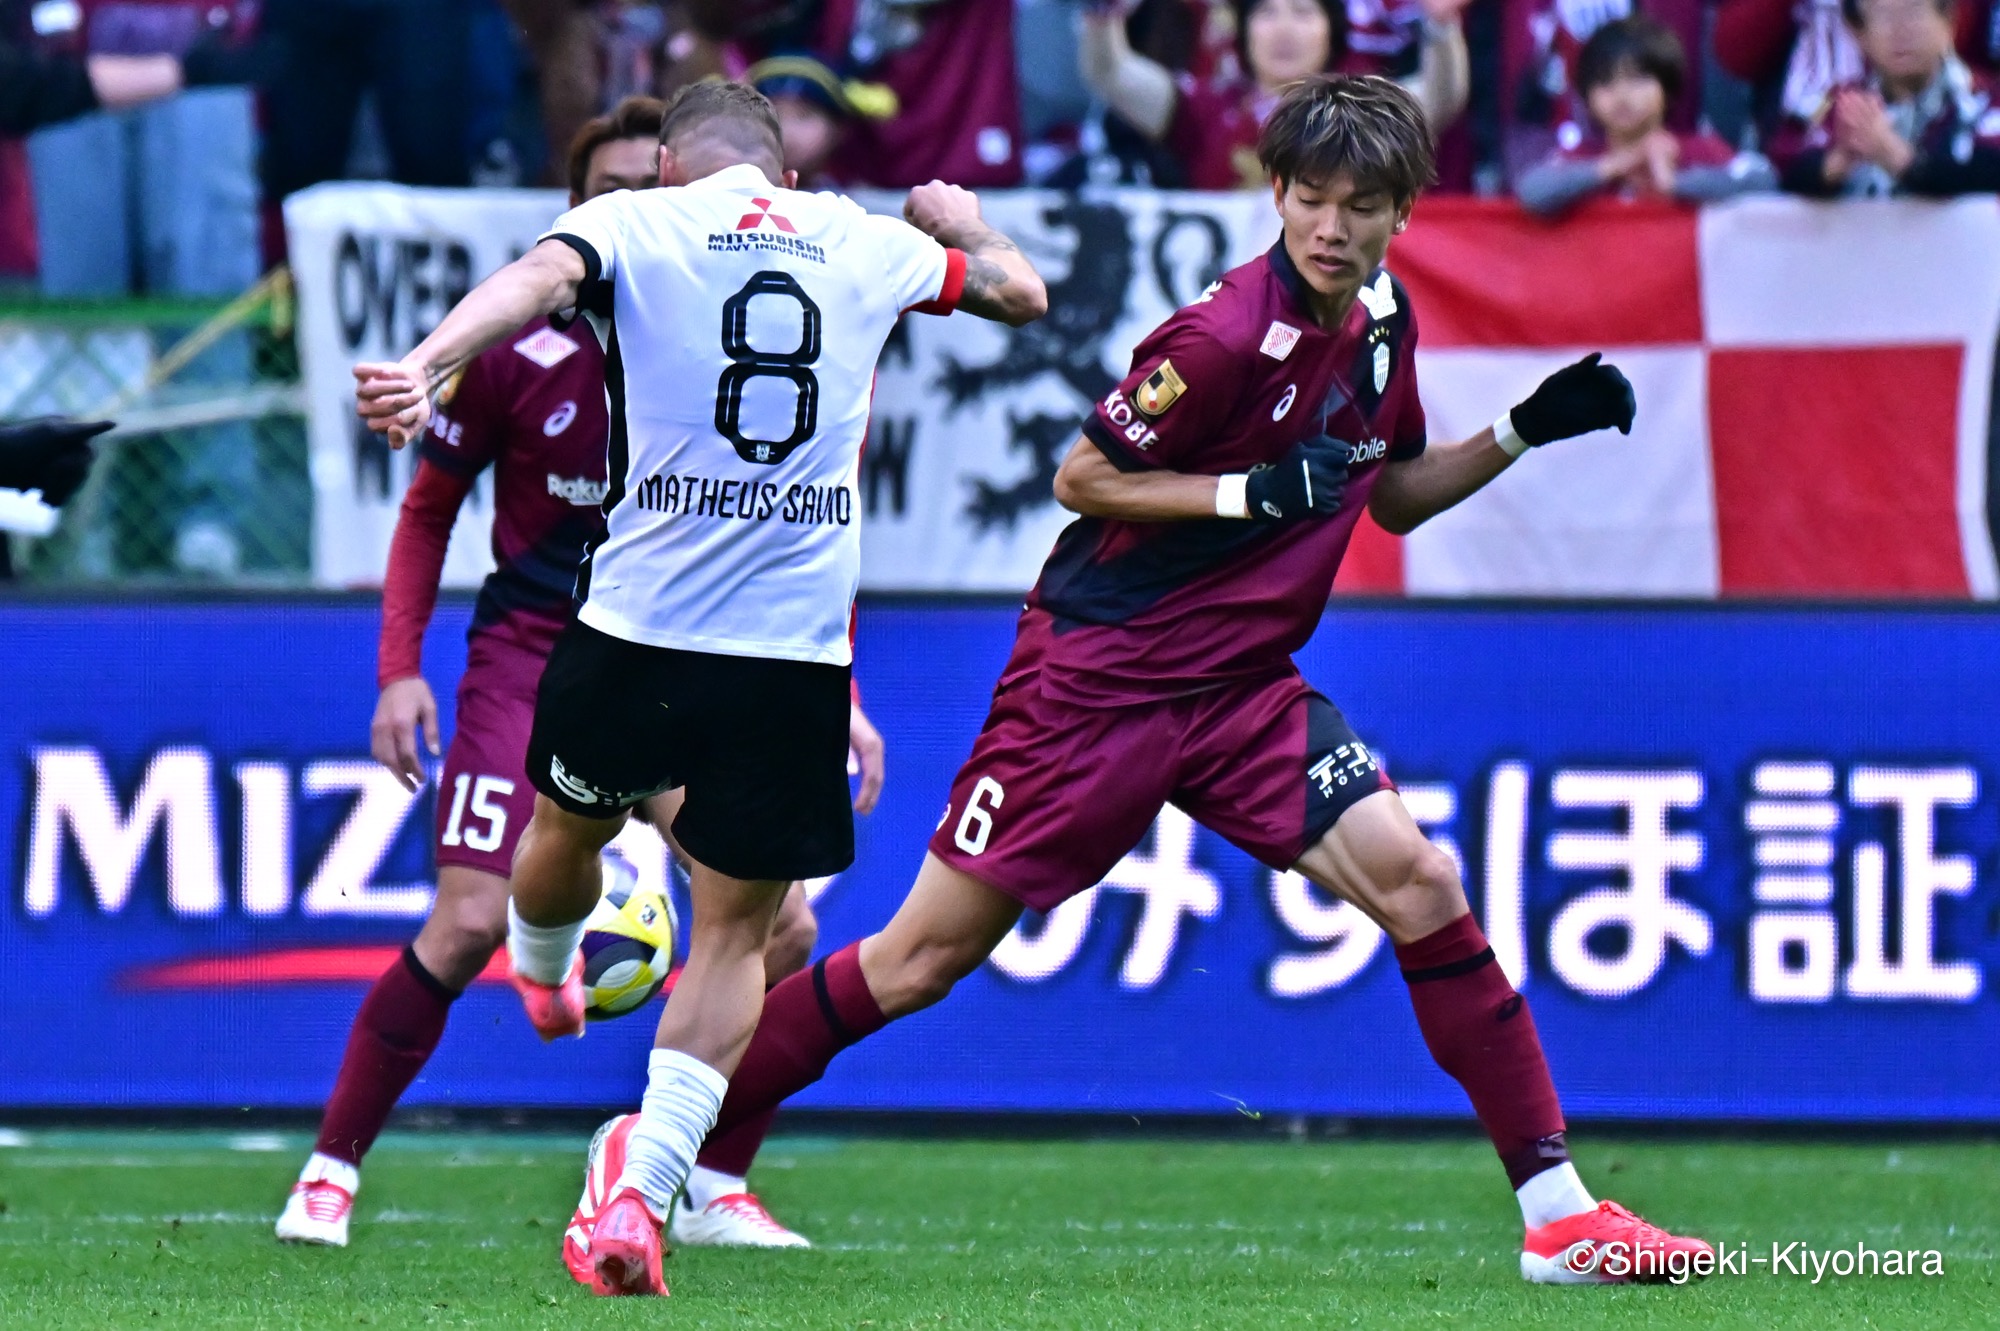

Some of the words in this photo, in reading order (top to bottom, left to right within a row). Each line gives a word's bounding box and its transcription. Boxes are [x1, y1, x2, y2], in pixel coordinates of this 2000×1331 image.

[708, 232, 825, 257] MITSUBISHI
[708, 243, 750, 252] HEAVY
[755, 243, 826, 264] INDUSTRIES
[714, 270, 822, 466] 8
[427, 403, 464, 447] BE
[1104, 389, 1160, 451] KOBE
[1347, 436, 1387, 464] obile
[547, 473, 608, 502] Raku
[637, 474, 778, 521] MATHEUS
[442, 772, 515, 853] 15
[954, 776, 1005, 856] 6
